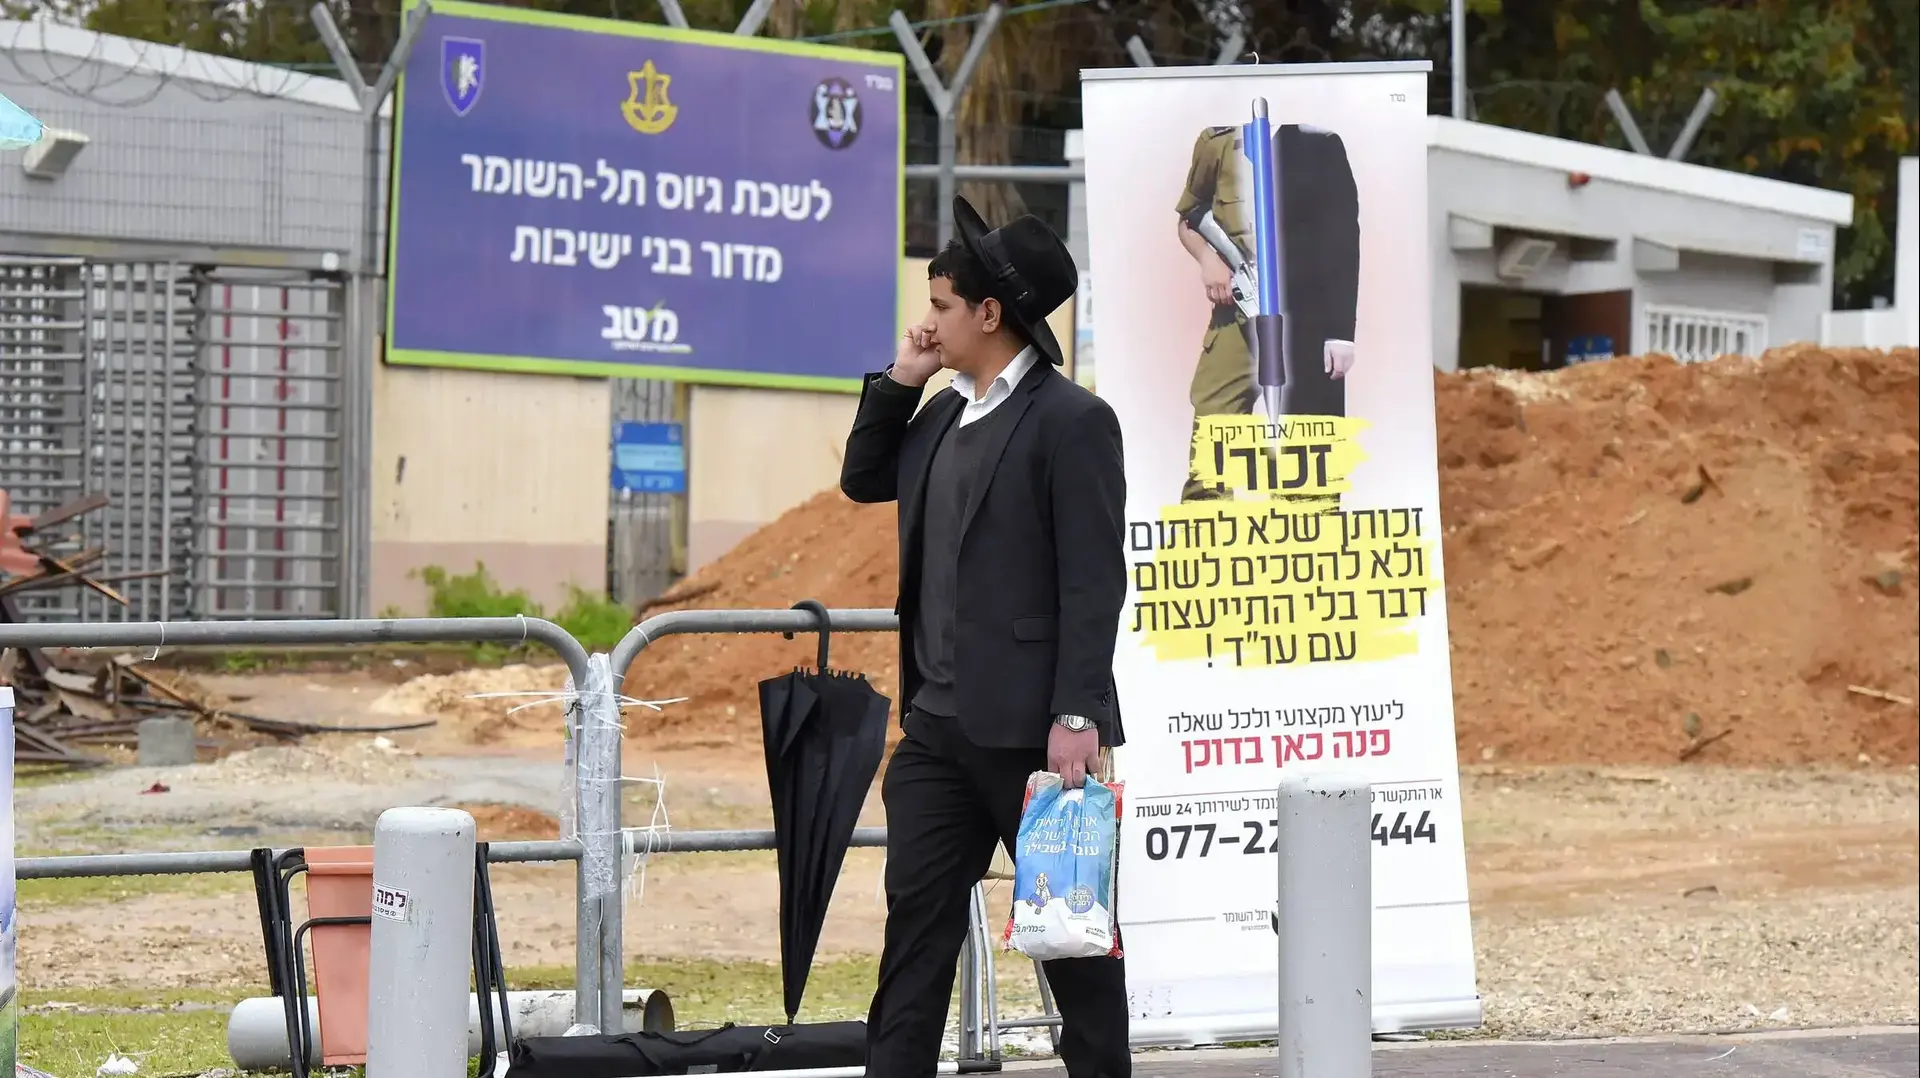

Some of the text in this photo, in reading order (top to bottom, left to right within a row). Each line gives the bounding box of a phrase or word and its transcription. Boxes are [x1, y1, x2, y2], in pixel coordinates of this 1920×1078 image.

[461, 153, 832, 222] לשכת גיוס תל-השומר
[511, 225, 783, 283] מדור בני ישיבות
[1213, 442, 1332, 493] זכור!
[1130, 507, 1423, 551] זכותך שלא לחתום
[1134, 543, 1424, 591] ולא להסכים לשום
[1132, 587, 1427, 632] דבר בלי התייעצות
[1225, 631, 1297, 666] עו"ד
[1308, 631, 1357, 663] עם
[1168, 700, 1404, 734] ליעוץ מקצועי ולכל שאלה
[1181, 728, 1391, 774] פנה כאן בדוכן
[1136, 804, 1171, 818] שעות
[1176, 803, 1192, 815] 24
[1193, 796, 1250, 816] לשירותך
[1252, 797, 1278, 811] ומד
[1379, 789, 1427, 805] התקשר
[1430, 788, 1443, 801] או
[376, 889, 406, 907] למה
[1223, 909, 1268, 923] תל השומר
